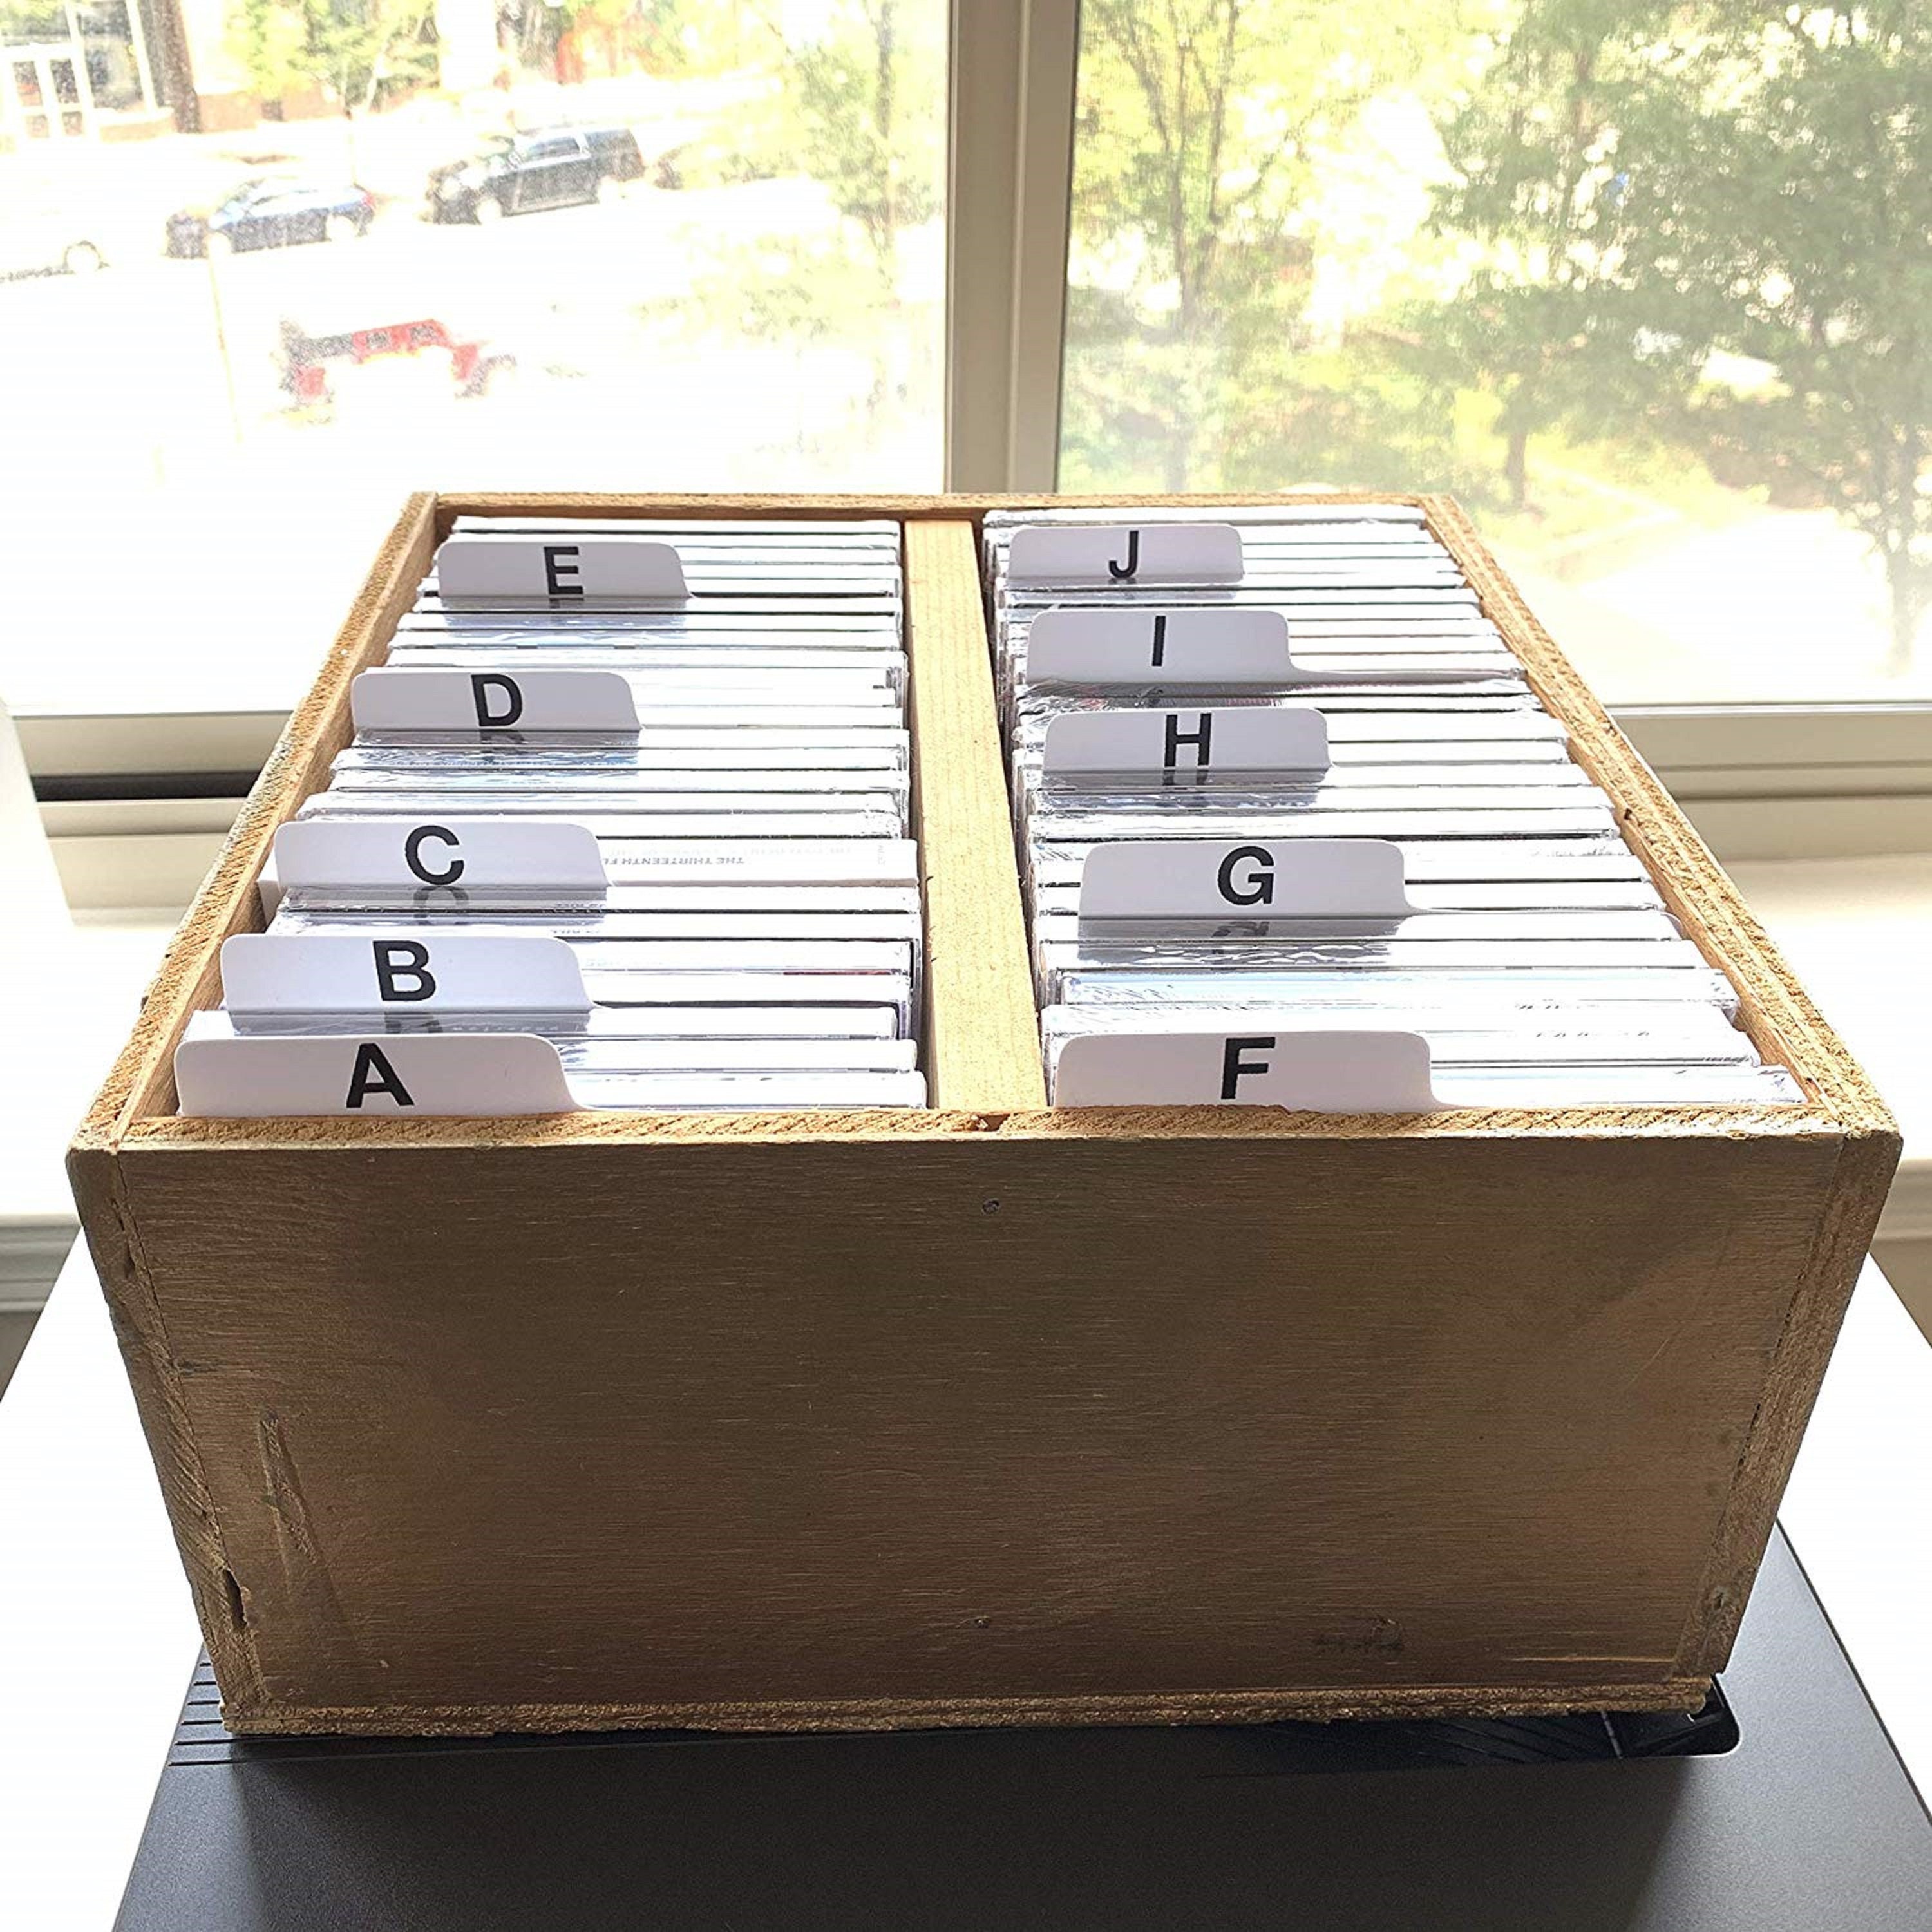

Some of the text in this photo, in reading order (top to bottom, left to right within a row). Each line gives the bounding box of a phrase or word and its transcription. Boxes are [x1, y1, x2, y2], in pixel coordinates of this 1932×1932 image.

[544, 547, 583, 595] E
[1109, 531, 1139, 578] J
[1152, 616, 1166, 666] I
[471, 674, 522, 727] D
[1164, 713, 1211, 767] H
[406, 826, 464, 885] C
[1218, 846, 1274, 905] G
[373, 941, 435, 1001] B
[346, 1043, 414, 1108] A
[1221, 1037, 1275, 1099] F
